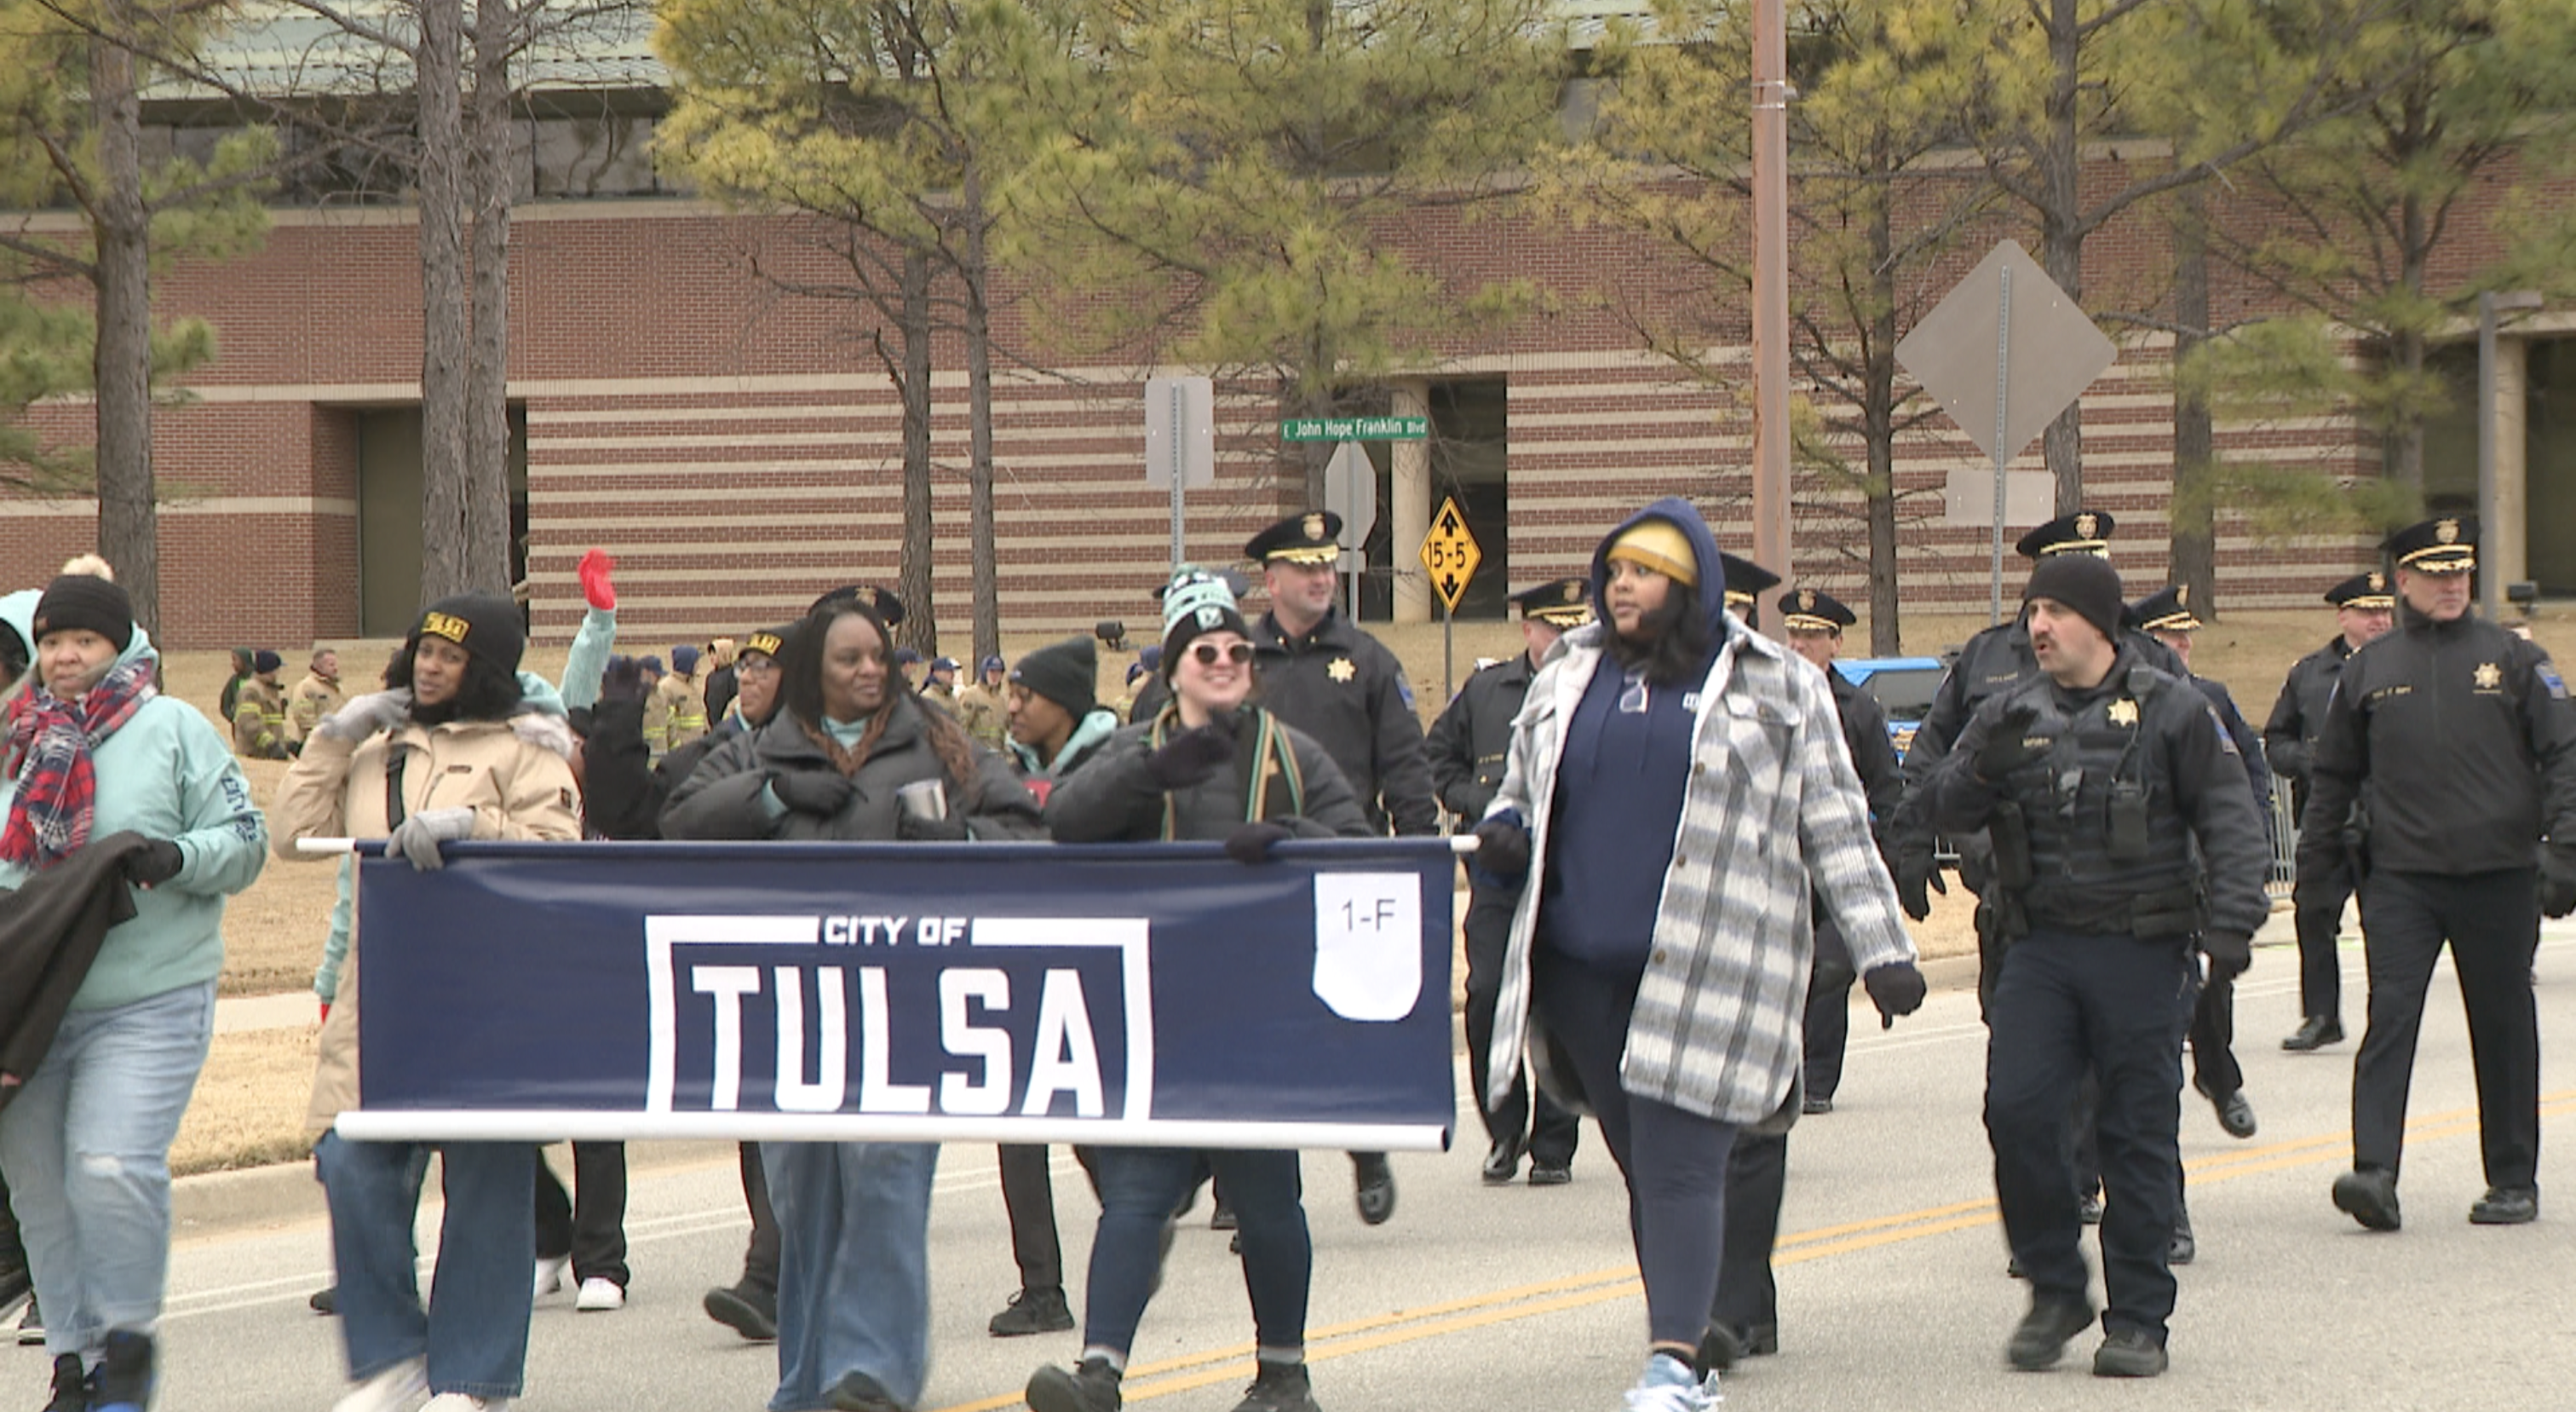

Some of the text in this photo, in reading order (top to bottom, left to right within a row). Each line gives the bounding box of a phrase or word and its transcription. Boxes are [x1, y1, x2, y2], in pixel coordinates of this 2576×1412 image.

[1283, 418, 1426, 440] E John Hope Franklin Blvd
[824, 915, 967, 945] CITY OF
[1341, 898, 1396, 931] 1-F
[692, 965, 1104, 1118] TULSA
